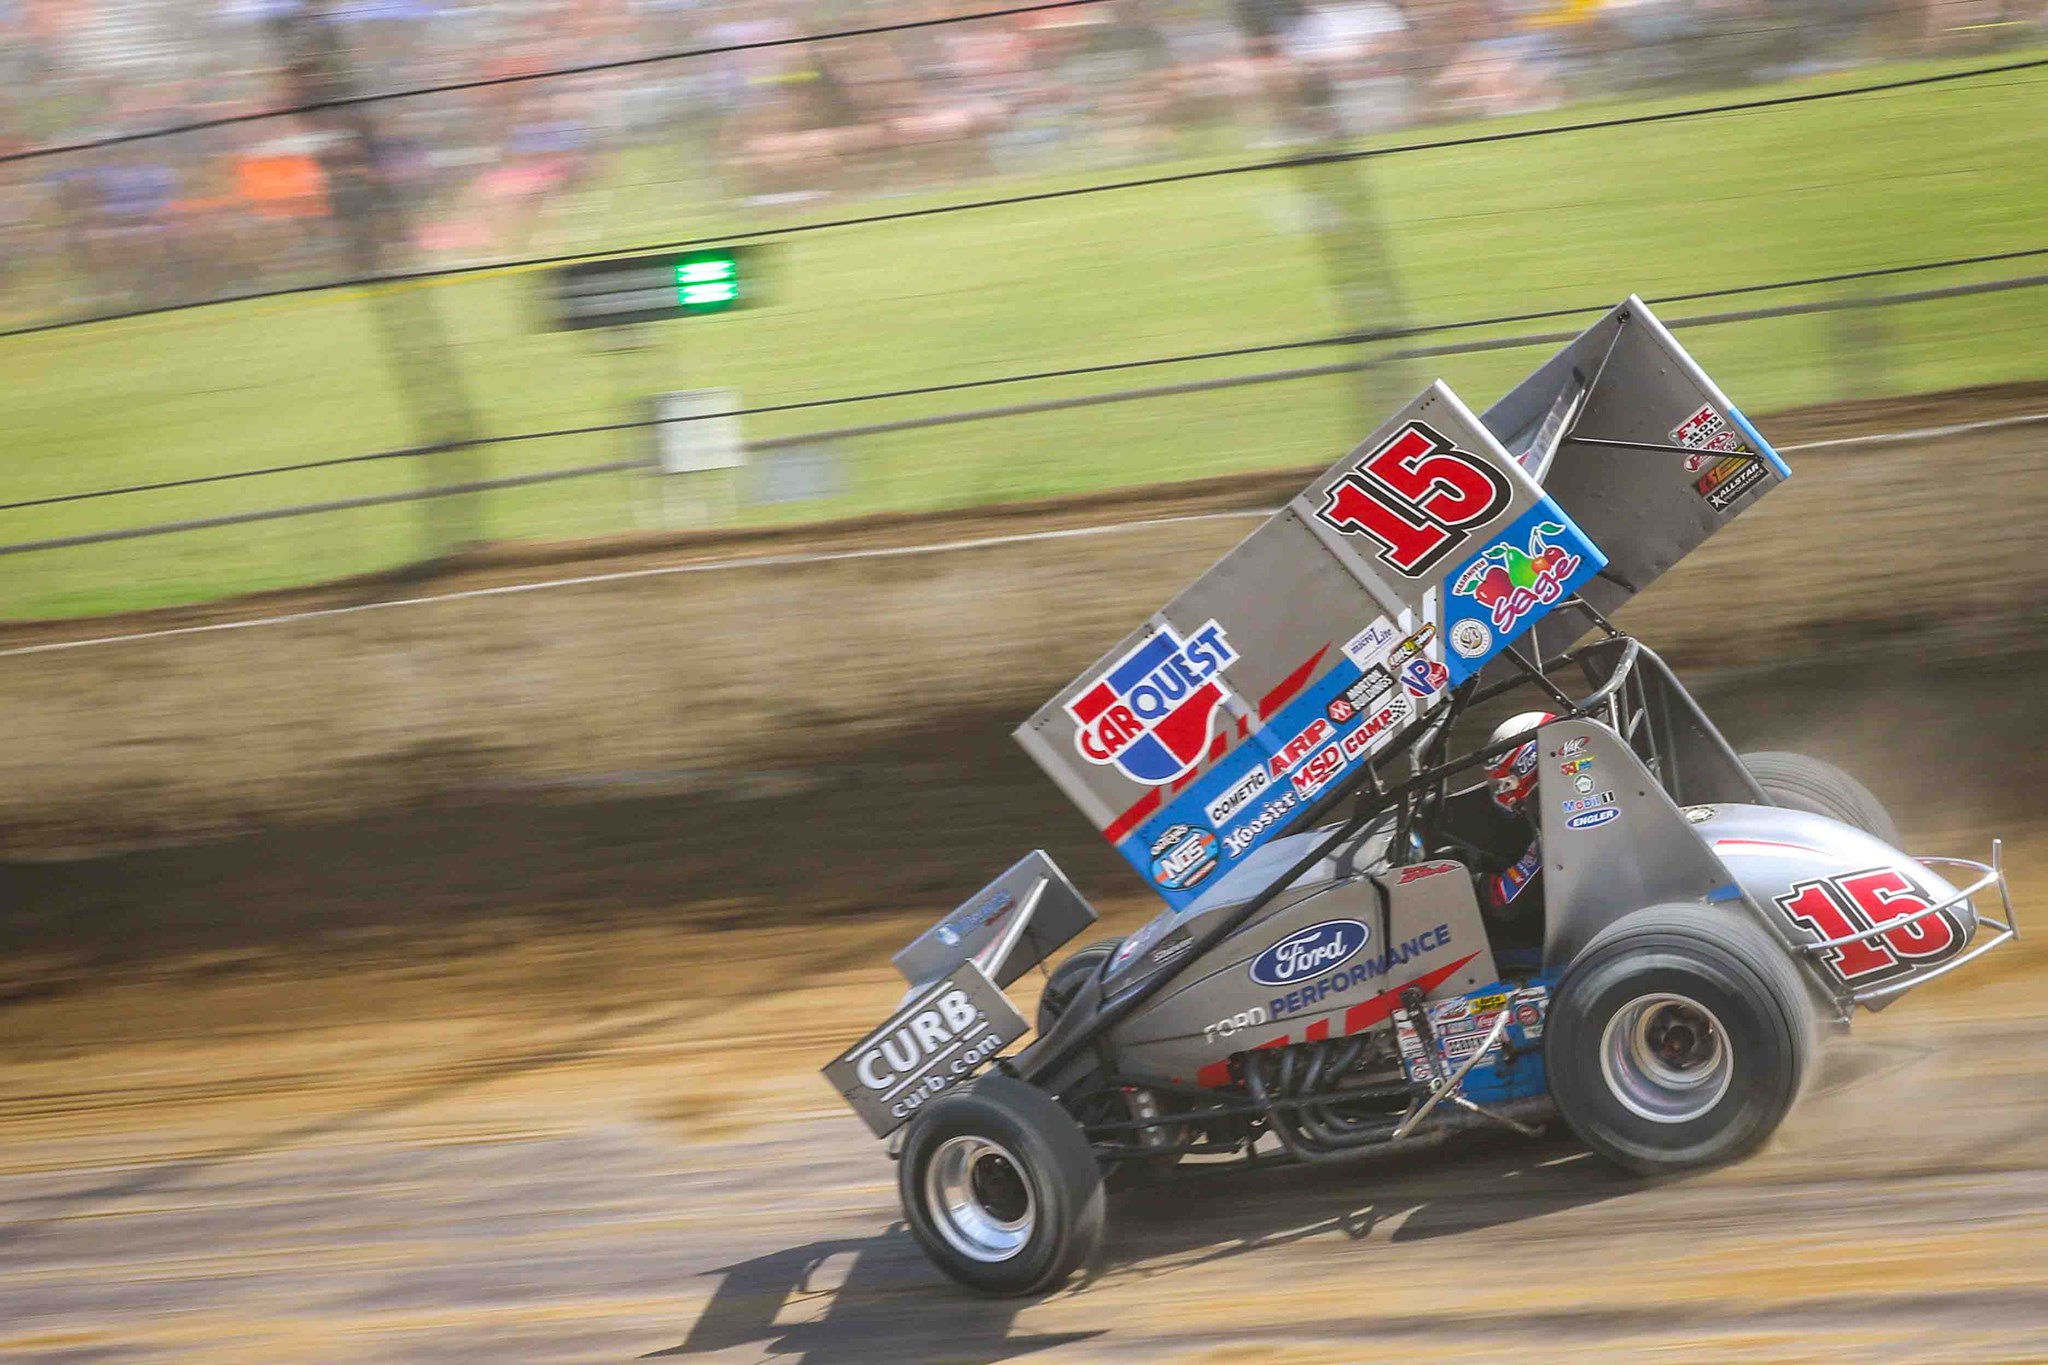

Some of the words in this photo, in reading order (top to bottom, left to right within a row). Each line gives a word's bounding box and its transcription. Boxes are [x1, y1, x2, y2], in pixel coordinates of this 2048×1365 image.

[1687, 416, 1718, 441] ROD
[1313, 419, 1514, 579] 15
[1720, 463, 1759, 497] ALLSTAR
[1400, 659, 1436, 697] VP
[1270, 718, 1327, 779] ARP
[1344, 708, 1392, 753] COMP
[1291, 746, 1340, 793] MSD
[1212, 771, 1266, 820] COMETIC
[1563, 795, 1600, 812] Mobil
[1573, 810, 1614, 827] ENGLER
[1221, 791, 1298, 859] Hoosier
[1772, 867, 1969, 990] 15
[1275, 931, 1348, 978] Ford
[1203, 1006, 1267, 1044] FORD
[1269, 924, 1452, 1020] PERFORMANCE
[856, 989, 978, 1090] CURB
[891, 1033, 1003, 1118] curb.com
